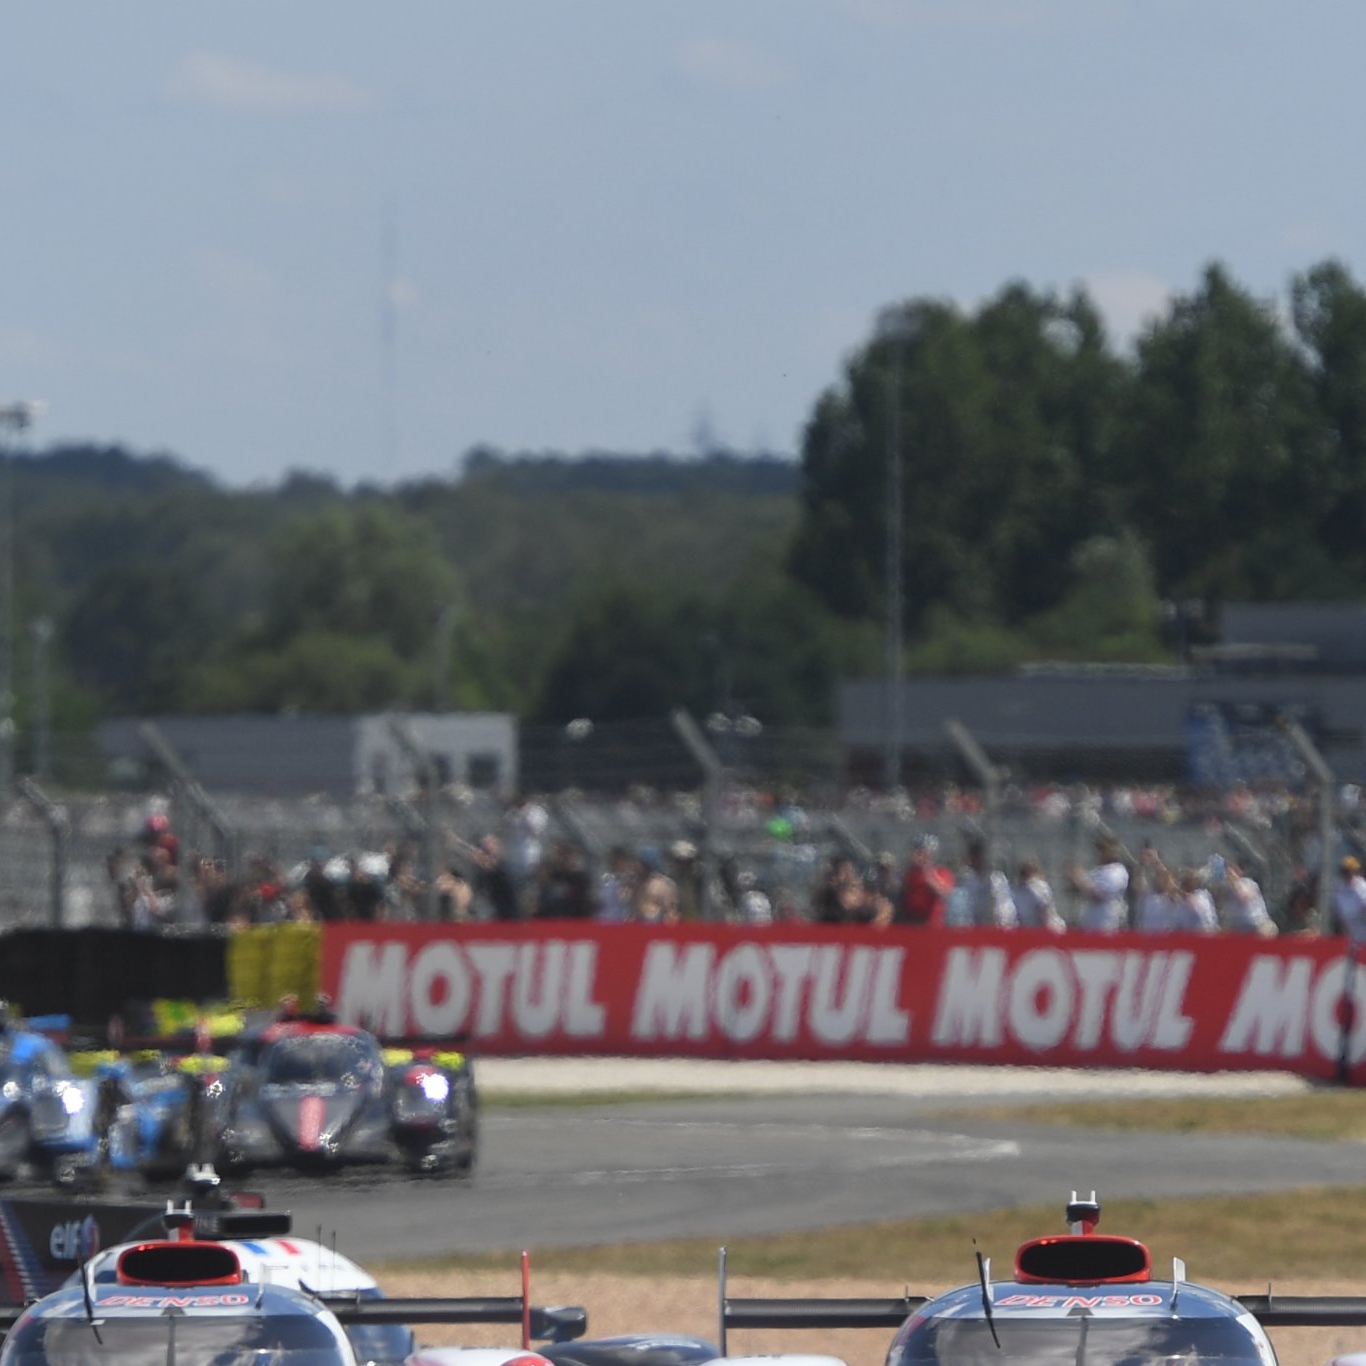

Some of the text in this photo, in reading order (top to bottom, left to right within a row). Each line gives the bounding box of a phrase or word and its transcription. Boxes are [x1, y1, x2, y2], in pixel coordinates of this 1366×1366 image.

[337, 940, 606, 1037] MOTUL
[633, 942, 912, 1043] MOTUL
[933, 947, 1197, 1050] MOTUL
[95, 1295, 248, 1307] DENSO
[993, 1294, 1162, 1308] DENSO
